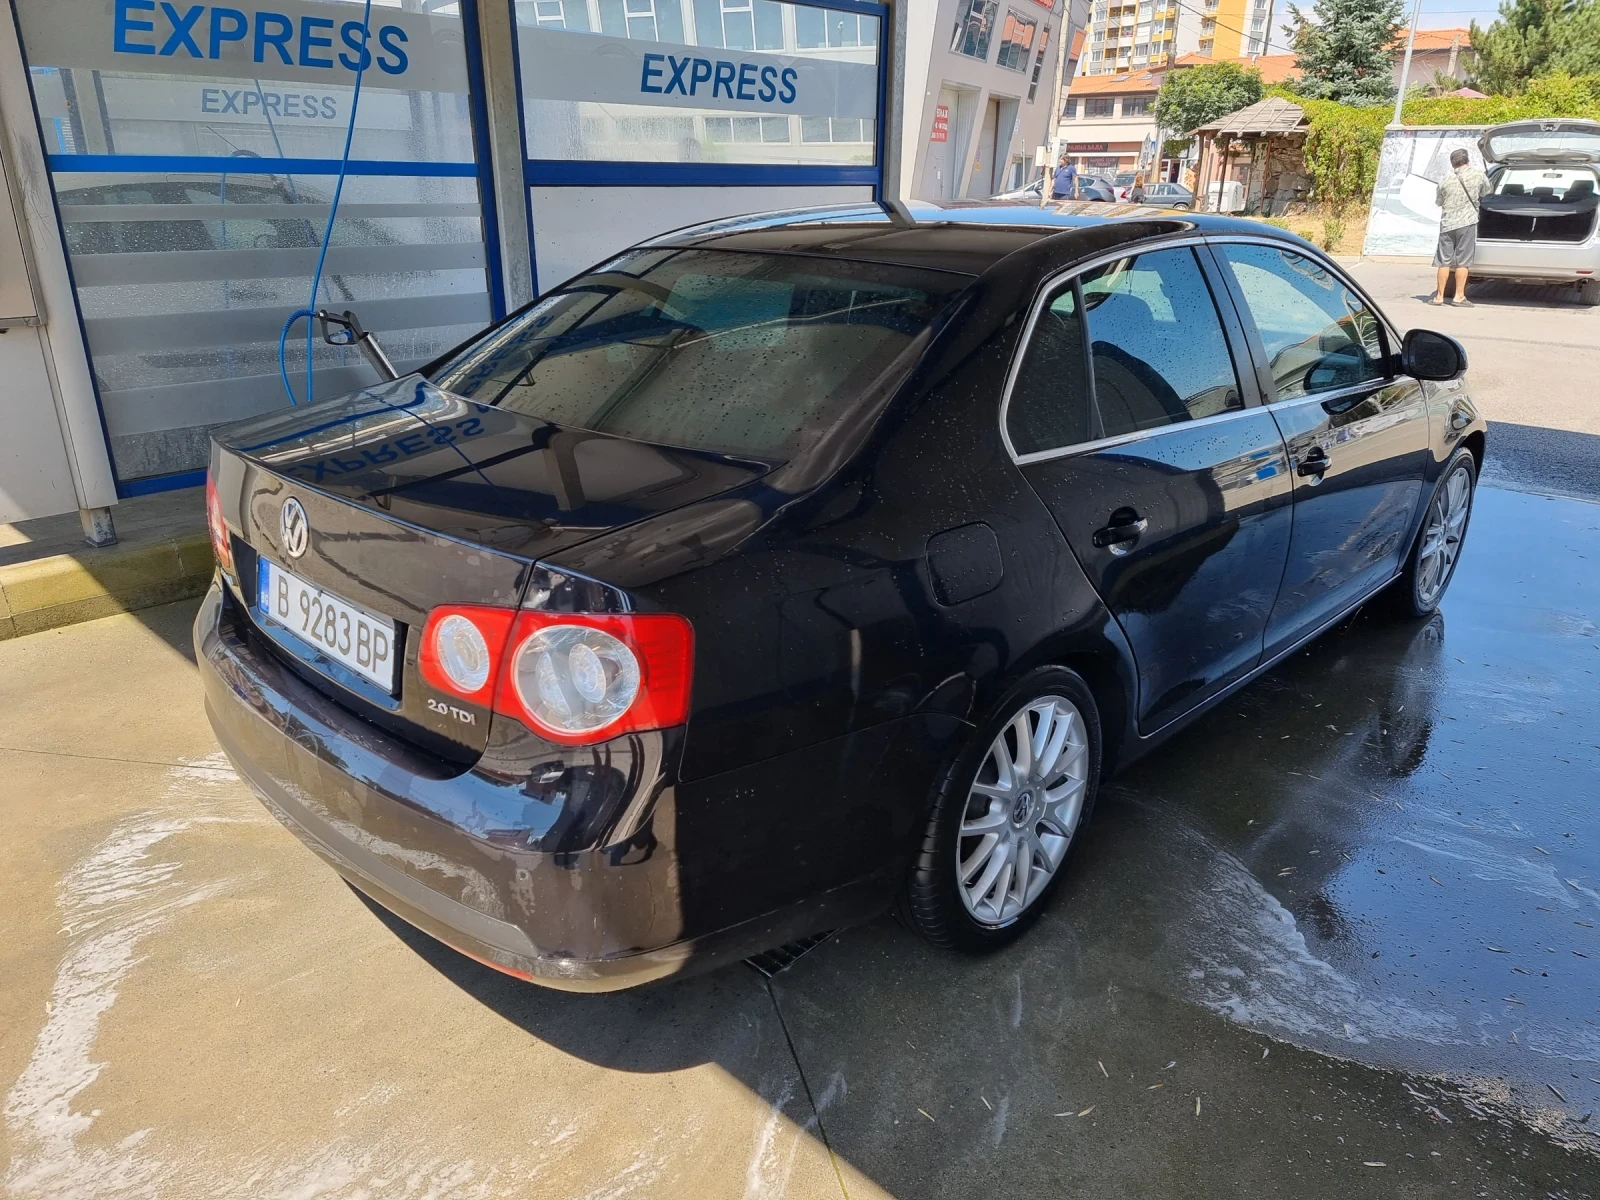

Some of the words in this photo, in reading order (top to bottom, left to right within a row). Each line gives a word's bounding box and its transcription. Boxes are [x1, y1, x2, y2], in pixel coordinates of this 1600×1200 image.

[114, 0, 409, 75] EXPRESS
[201, 88, 337, 120] EXPRESS
[640, 52, 798, 104] EXPRESS
[277, 574, 289, 619] B
[299, 589, 352, 656] 9283
[355, 619, 389, 674] BP
[449, 705, 476, 726] TDI
